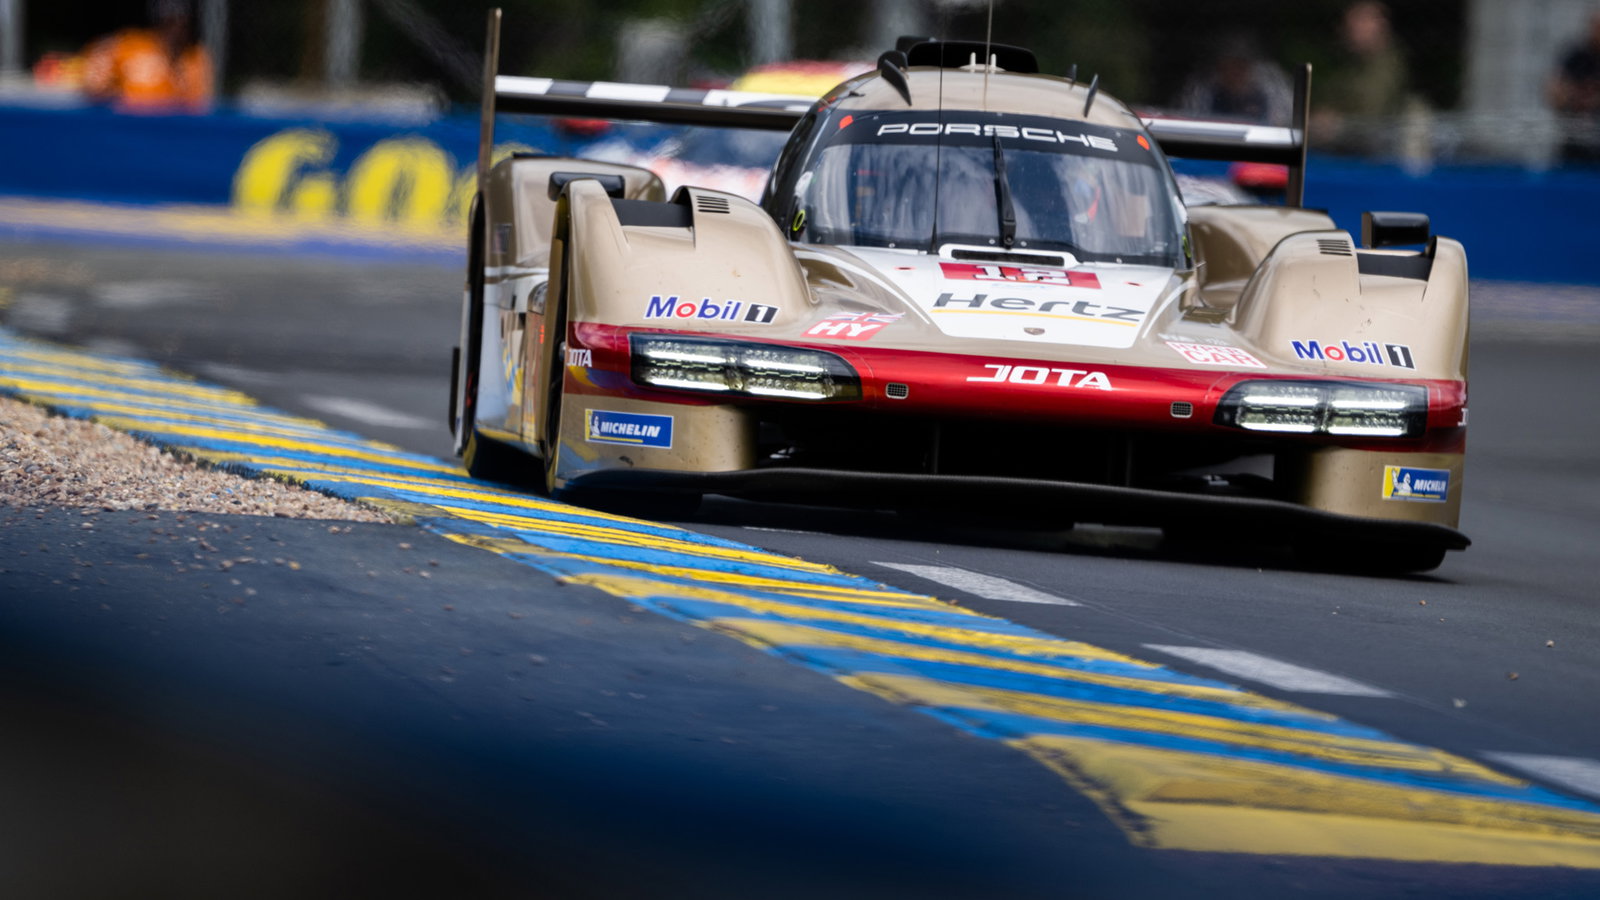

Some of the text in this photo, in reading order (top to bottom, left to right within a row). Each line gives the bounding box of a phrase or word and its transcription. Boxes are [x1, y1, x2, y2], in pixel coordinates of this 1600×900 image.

[877, 123, 1118, 152] PORSCHE
[974, 265, 1071, 285] 12
[645, 296, 742, 320] Mobil
[932, 292, 1145, 322] Hertz
[807, 323, 881, 337] HY
[568, 349, 592, 367] JOTA
[1183, 351, 1260, 366] CAR
[1291, 340, 1384, 364] Mobil
[966, 364, 1112, 391] JOTA
[600, 421, 661, 438] MICHELIN
[1414, 479, 1447, 492] MICHELIN
